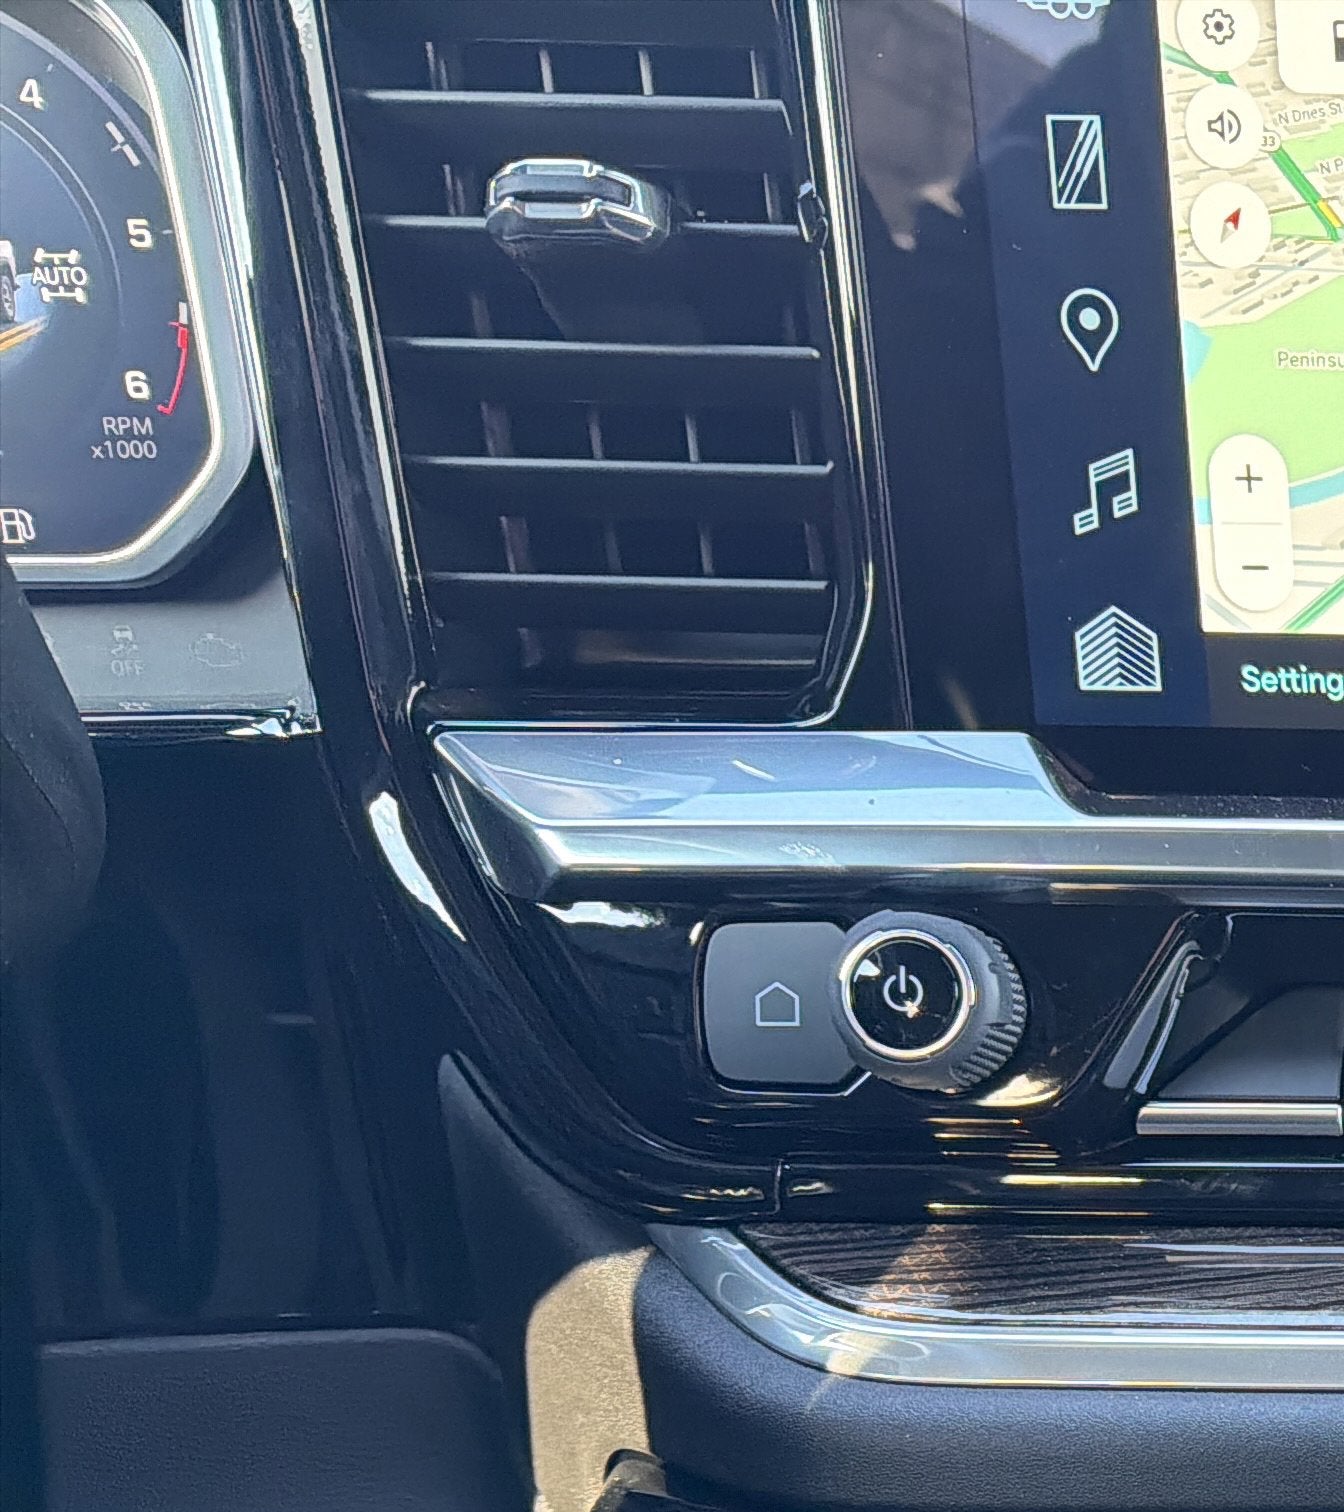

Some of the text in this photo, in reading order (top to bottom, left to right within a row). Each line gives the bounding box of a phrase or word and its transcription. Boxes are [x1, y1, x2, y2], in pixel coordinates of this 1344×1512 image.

[19, 78, 45, 110] 4
[1278, 113, 1289, 124] N
[1328, 102, 1344, 114] St
[1320, 163, 1329, 174] N
[126, 219, 153, 248] 5
[32, 267, 87, 286] AUTO
[125, 370, 149, 400] 6
[102, 416, 153, 436] RPM
[91, 440, 157, 459] x1000
